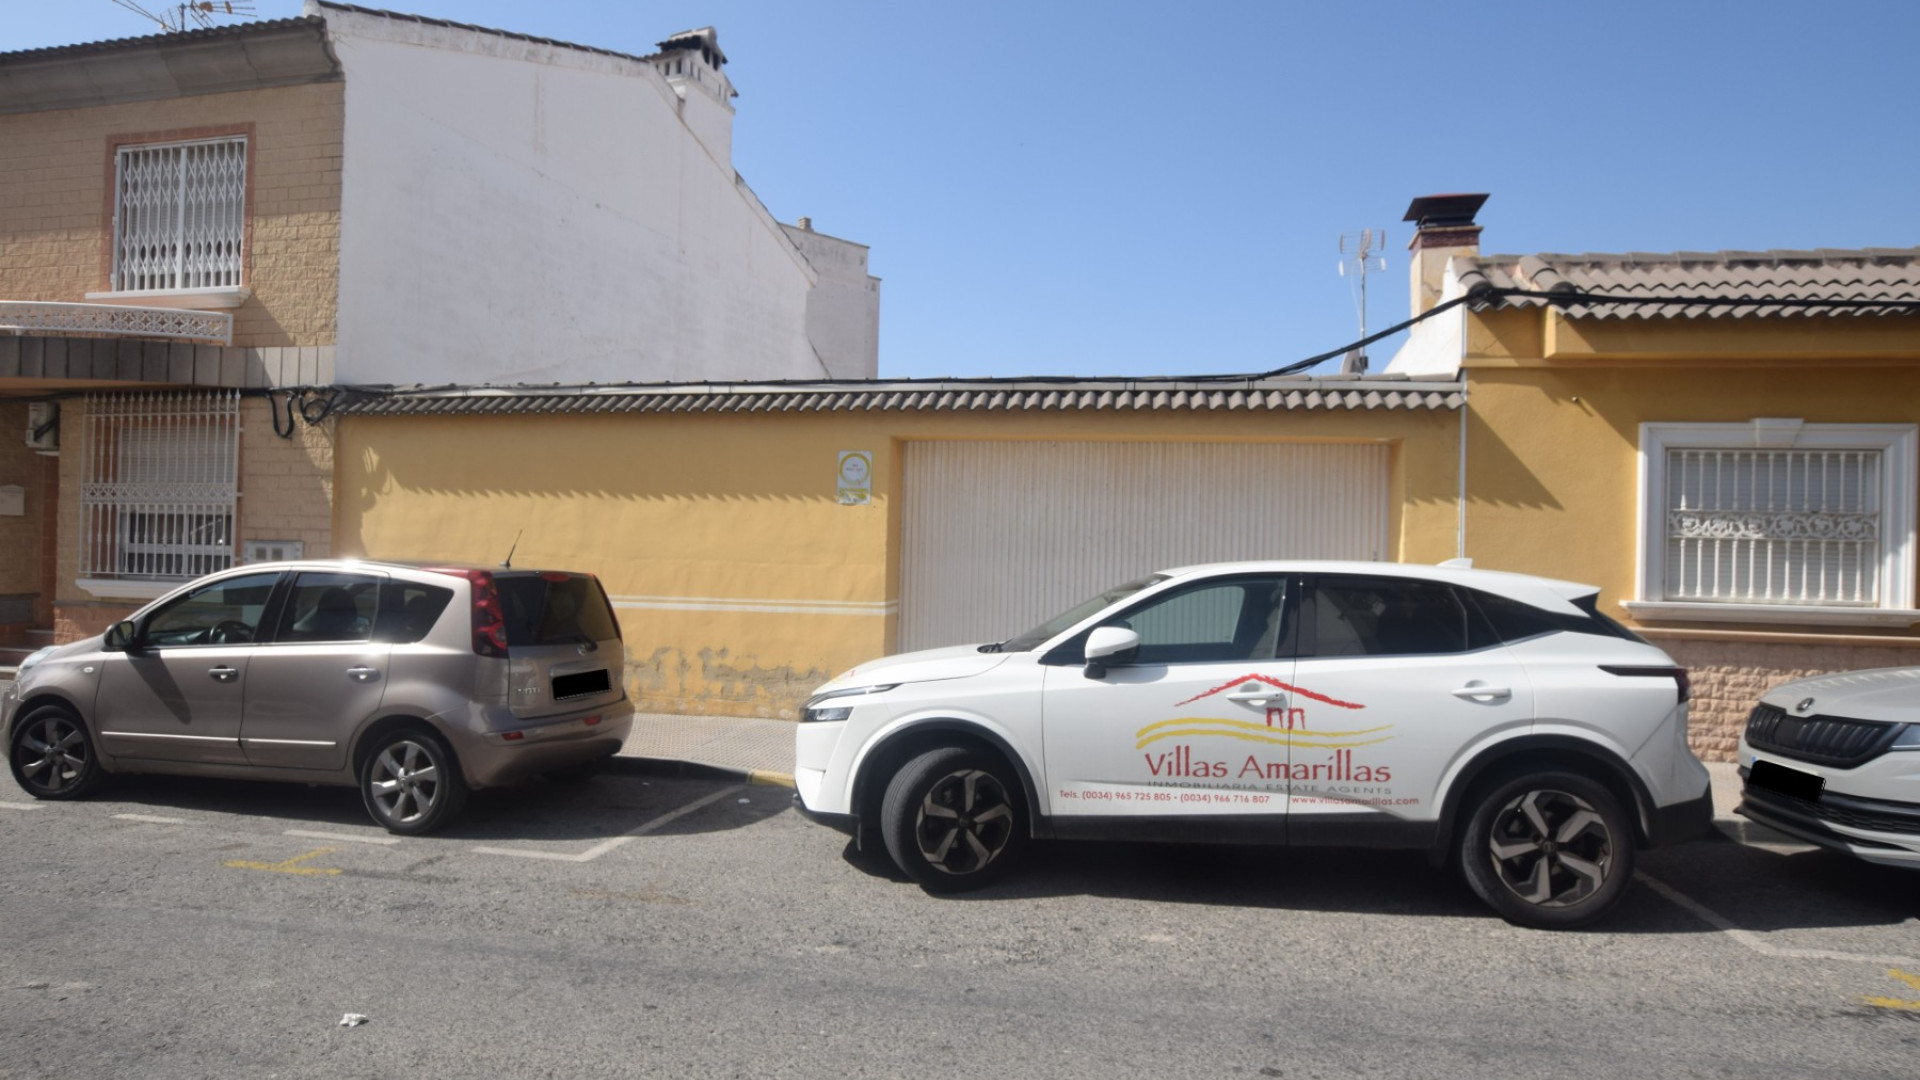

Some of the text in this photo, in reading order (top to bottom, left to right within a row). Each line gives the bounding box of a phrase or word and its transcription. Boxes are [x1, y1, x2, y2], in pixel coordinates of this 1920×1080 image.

[1148, 781, 1392, 795] INMOBILIARIA ESTATE AGENTS
[1060, 790, 1080, 799] Tels.
[1082, 791, 1113, 801] (0034)
[1115, 791, 1132, 800] 965
[1134, 792, 1151, 801] 725
[1153, 793, 1172, 801] 805
[1180, 793, 1212, 803] (0034)
[1214, 794, 1231, 803] 966
[1233, 795, 1250, 803] 716
[1252, 795, 1270, 804] 807
